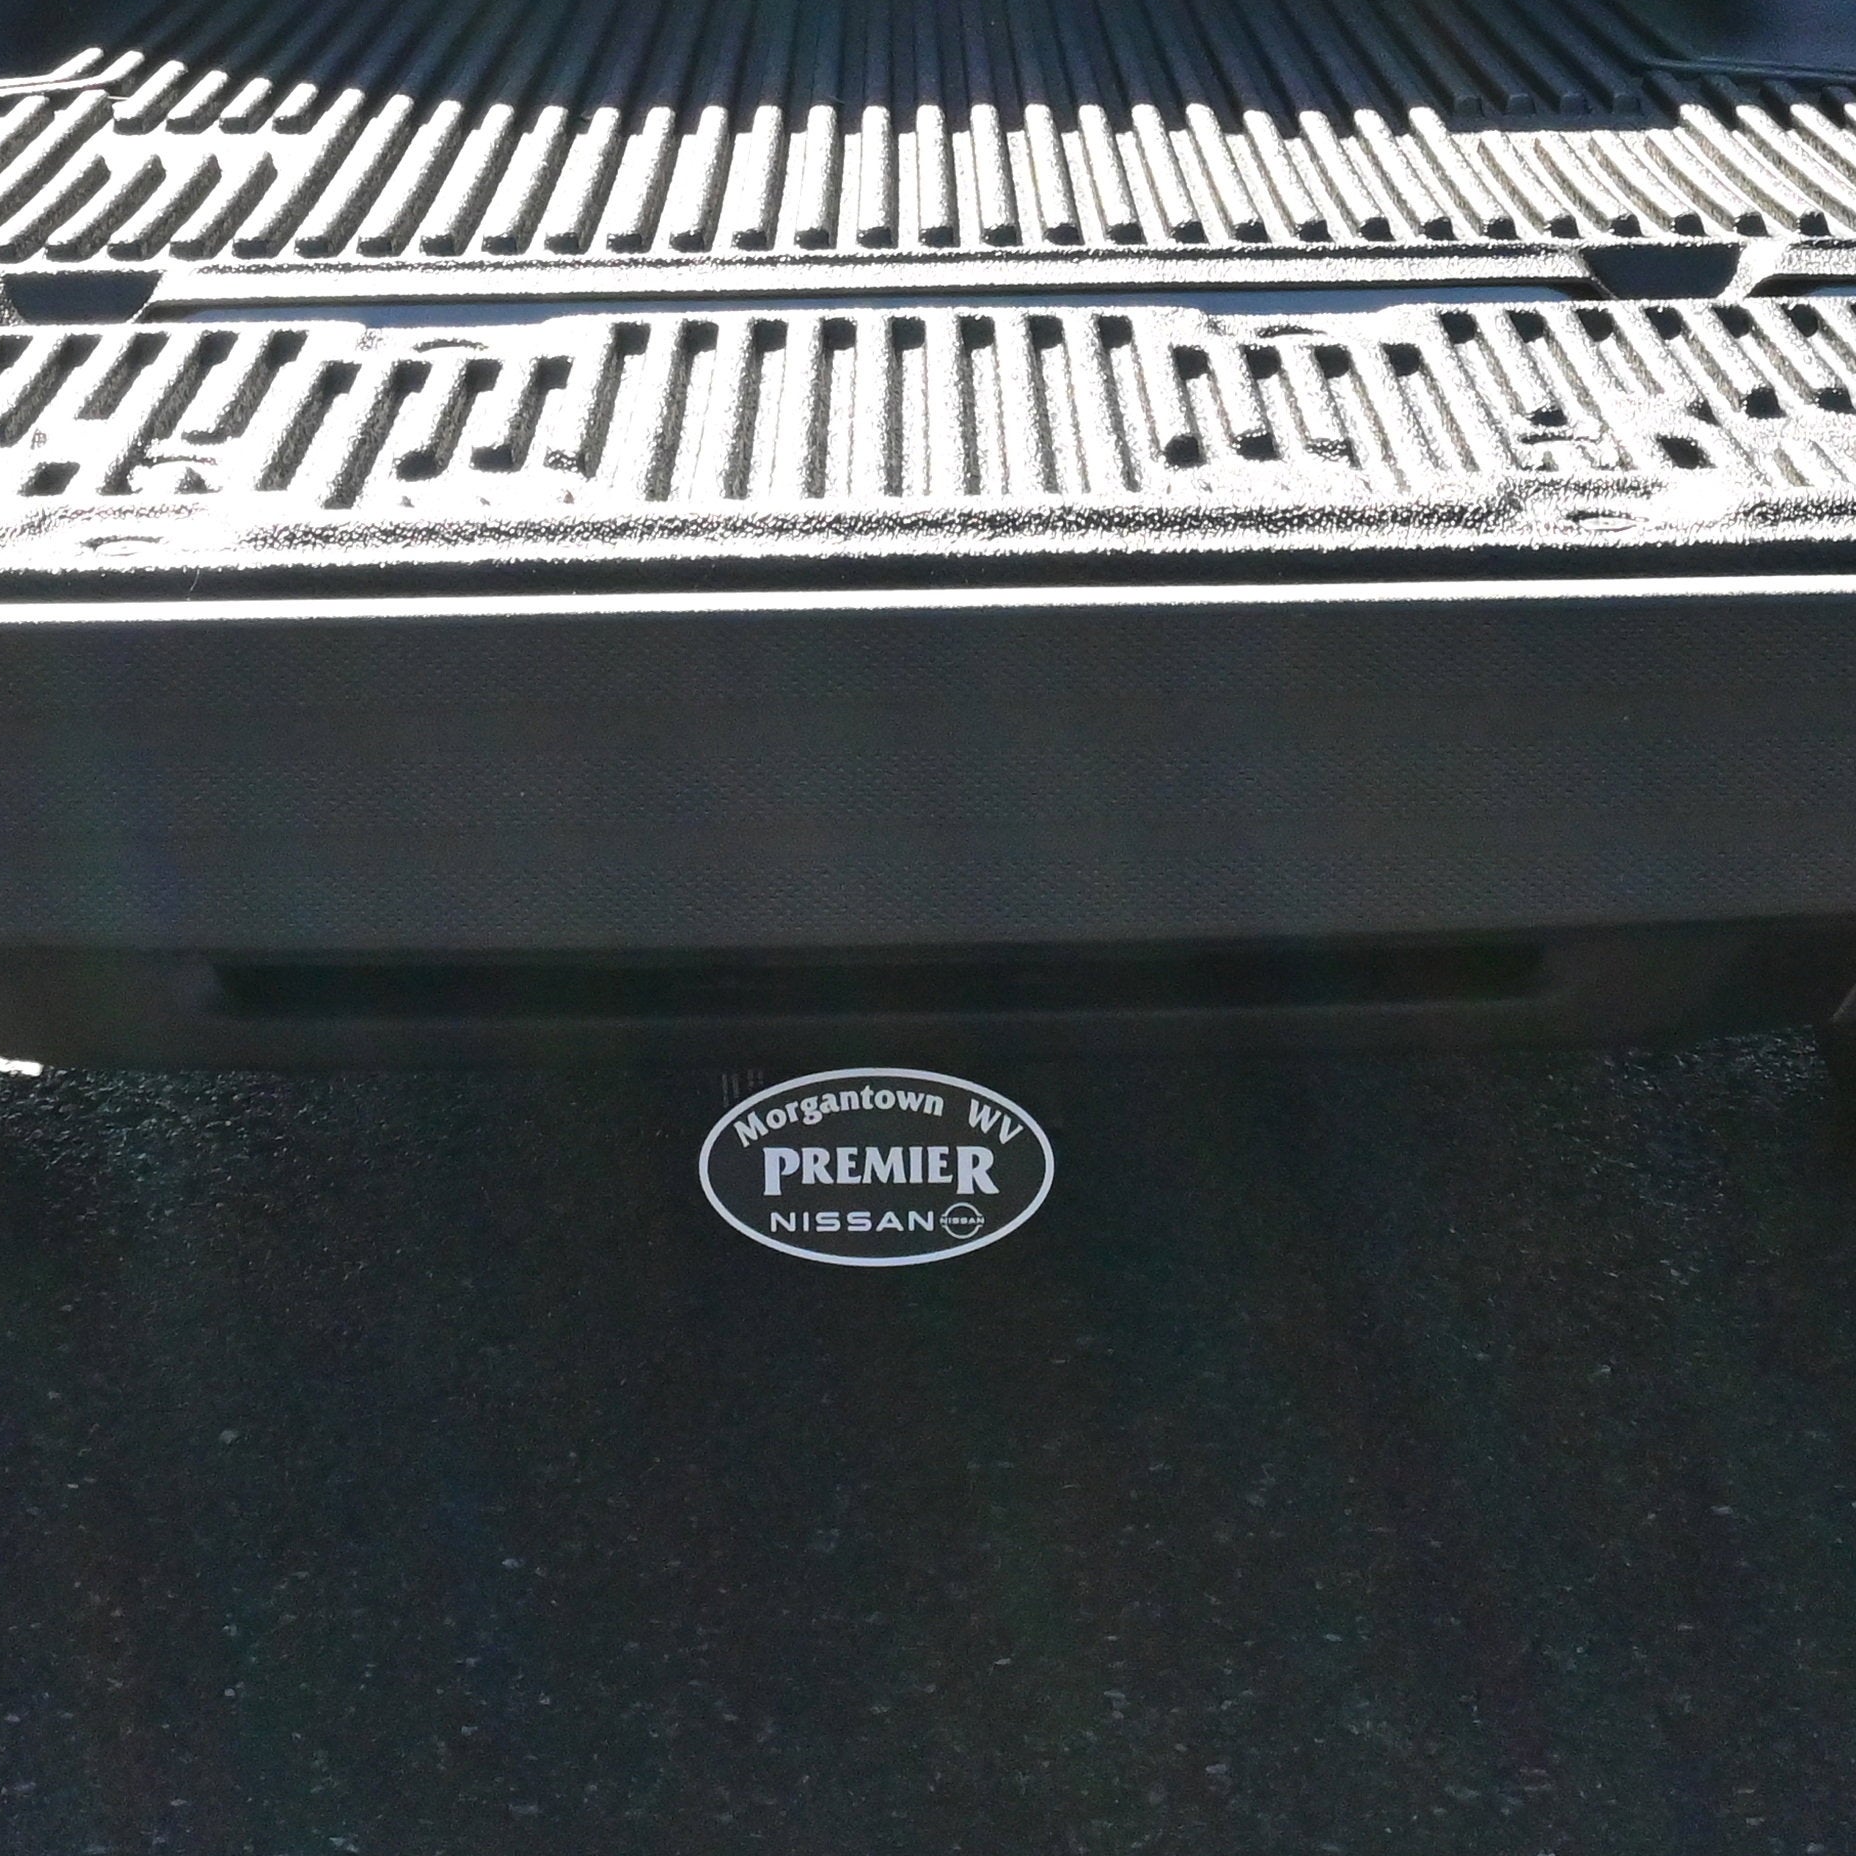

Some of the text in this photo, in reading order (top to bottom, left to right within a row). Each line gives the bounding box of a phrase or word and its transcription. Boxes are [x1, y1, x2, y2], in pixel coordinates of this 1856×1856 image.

[733, 1085, 1025, 1148] Morgantown WV
[763, 1145, 1001, 1196] PREMIER
[770, 1210, 934, 1232] NISSAN
